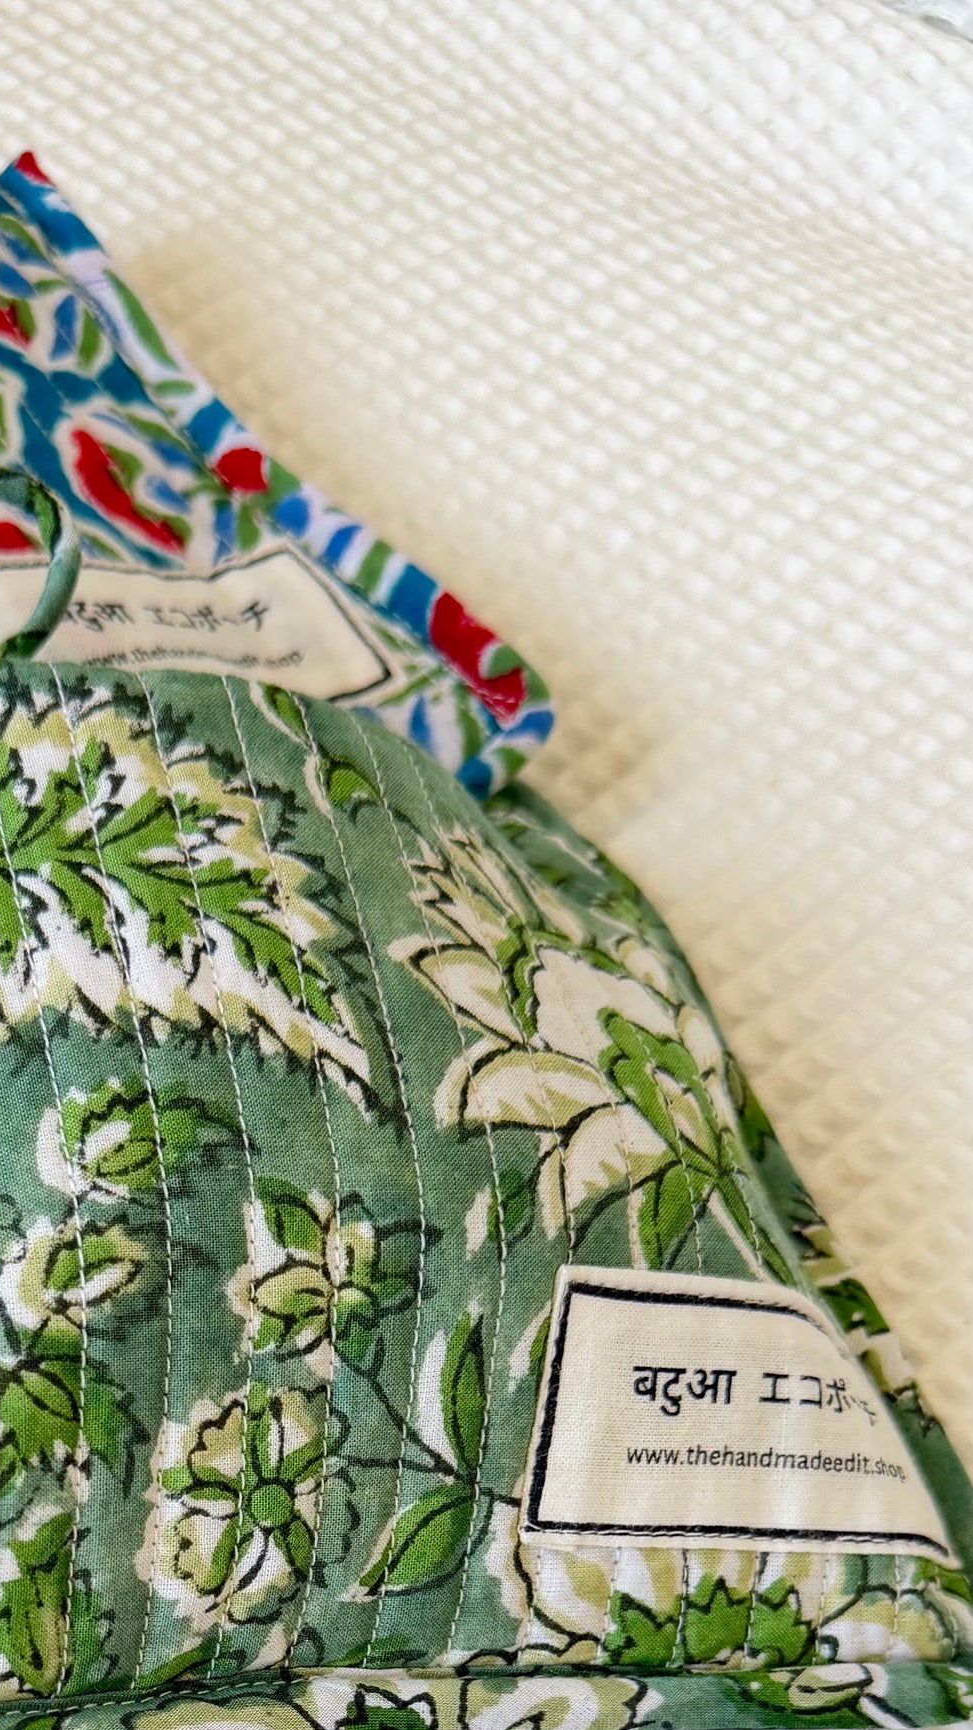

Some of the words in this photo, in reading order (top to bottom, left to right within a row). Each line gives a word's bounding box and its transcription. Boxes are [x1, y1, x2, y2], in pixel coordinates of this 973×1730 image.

[142, 601, 269, 633] エコポーチ
[632, 1365, 737, 1416] बटुआ
[758, 1372, 877, 1427] エコポーチ
[626, 1445, 907, 1484] www.thehandmadeedit.shop
